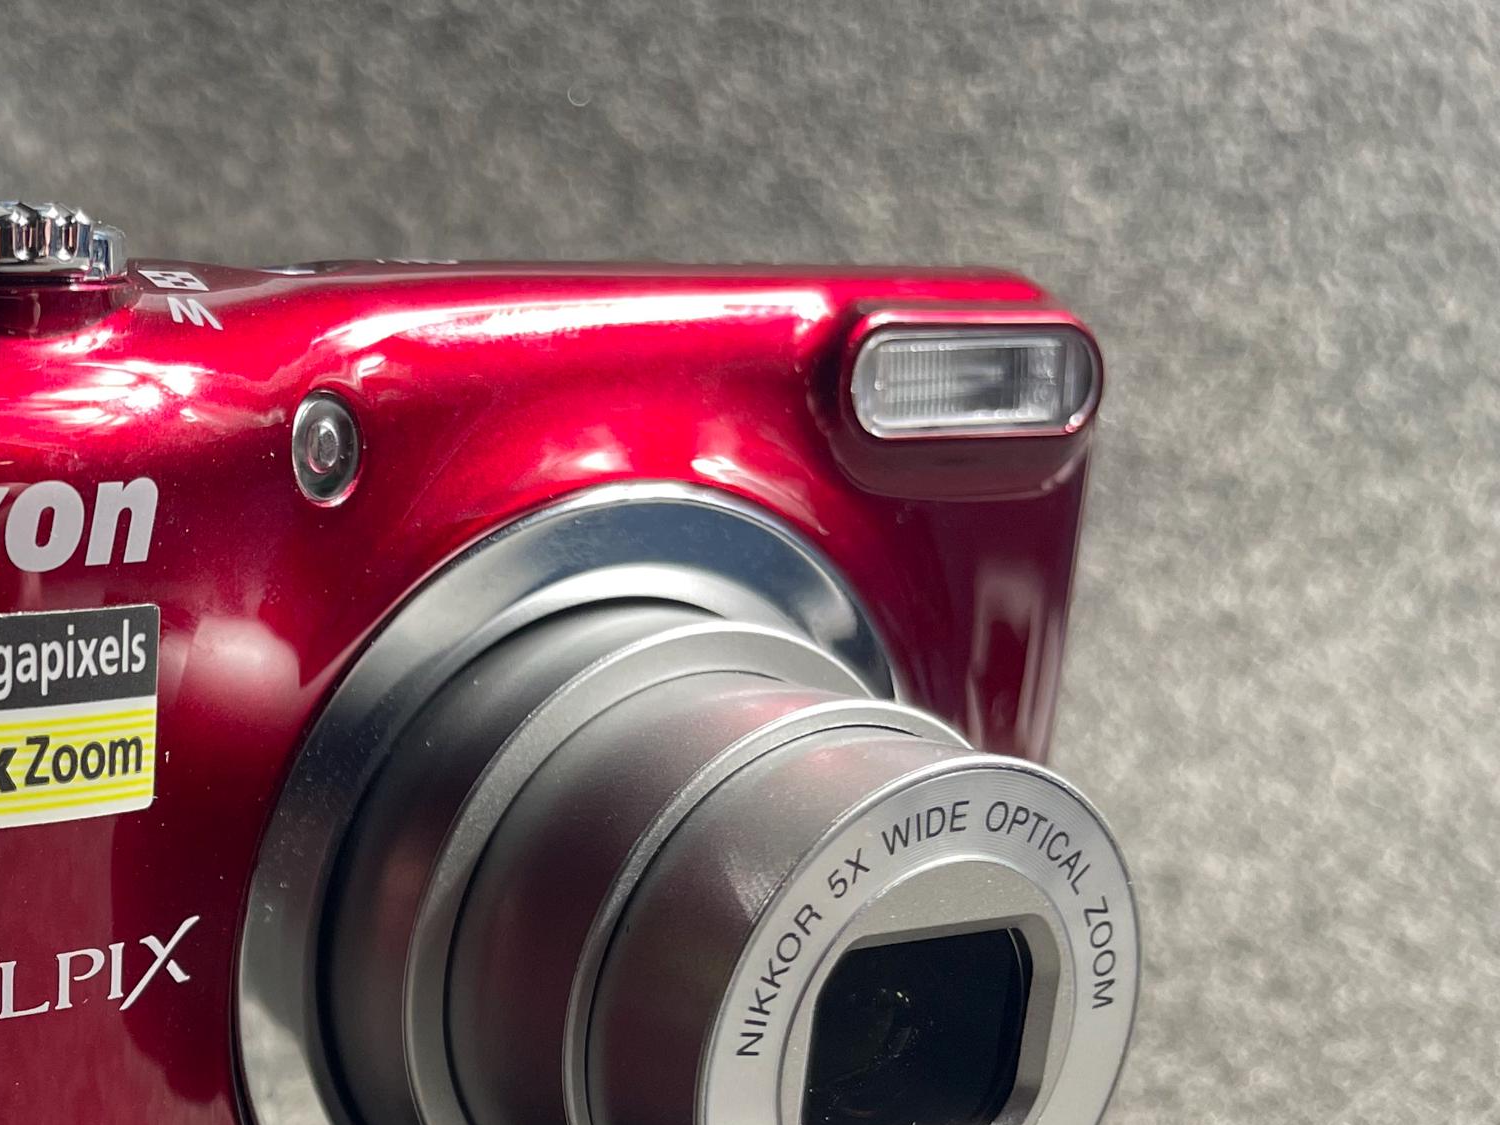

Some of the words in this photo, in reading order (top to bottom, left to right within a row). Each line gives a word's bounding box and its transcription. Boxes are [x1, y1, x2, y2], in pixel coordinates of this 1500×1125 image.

[167, 296, 224, 331] W
[24, 734, 144, 788] Zoom
[736, 903, 822, 1057] NIKKOR
[827, 848, 871, 899] 5X
[881, 800, 971, 855] WIDE
[985, 800, 1094, 894] OPTICAL
[1083, 895, 1115, 1010] ZOOM
